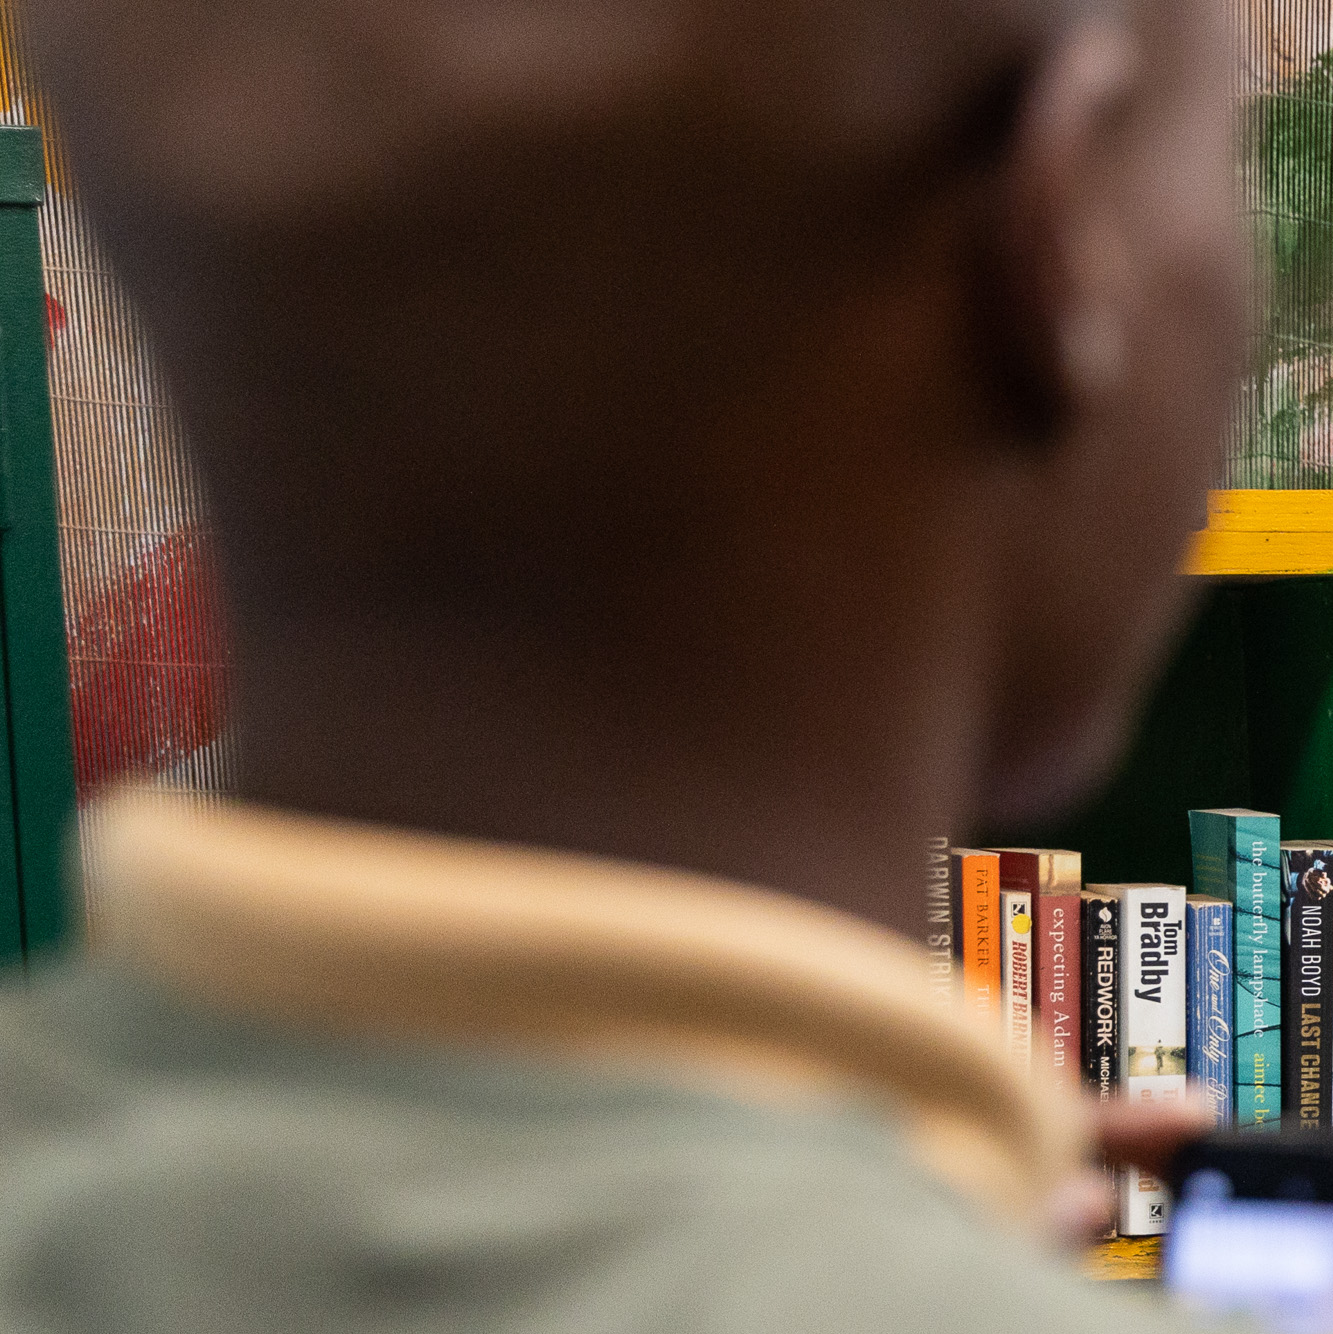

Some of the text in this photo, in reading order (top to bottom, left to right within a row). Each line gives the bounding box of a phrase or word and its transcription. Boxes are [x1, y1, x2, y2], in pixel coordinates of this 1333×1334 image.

[1050, 908, 1070, 1067] expecting Adam
[1135, 902, 1169, 1004] Bradby
[1163, 920, 1182, 956] Tom
[1249, 840, 1268, 1038] the butterfly lampshade
[1301, 906, 1322, 996] NOAH BOYD
[1097, 946, 1114, 1046] REDWORK
[1300, 1002, 1320, 1131] LAST CHANCE
